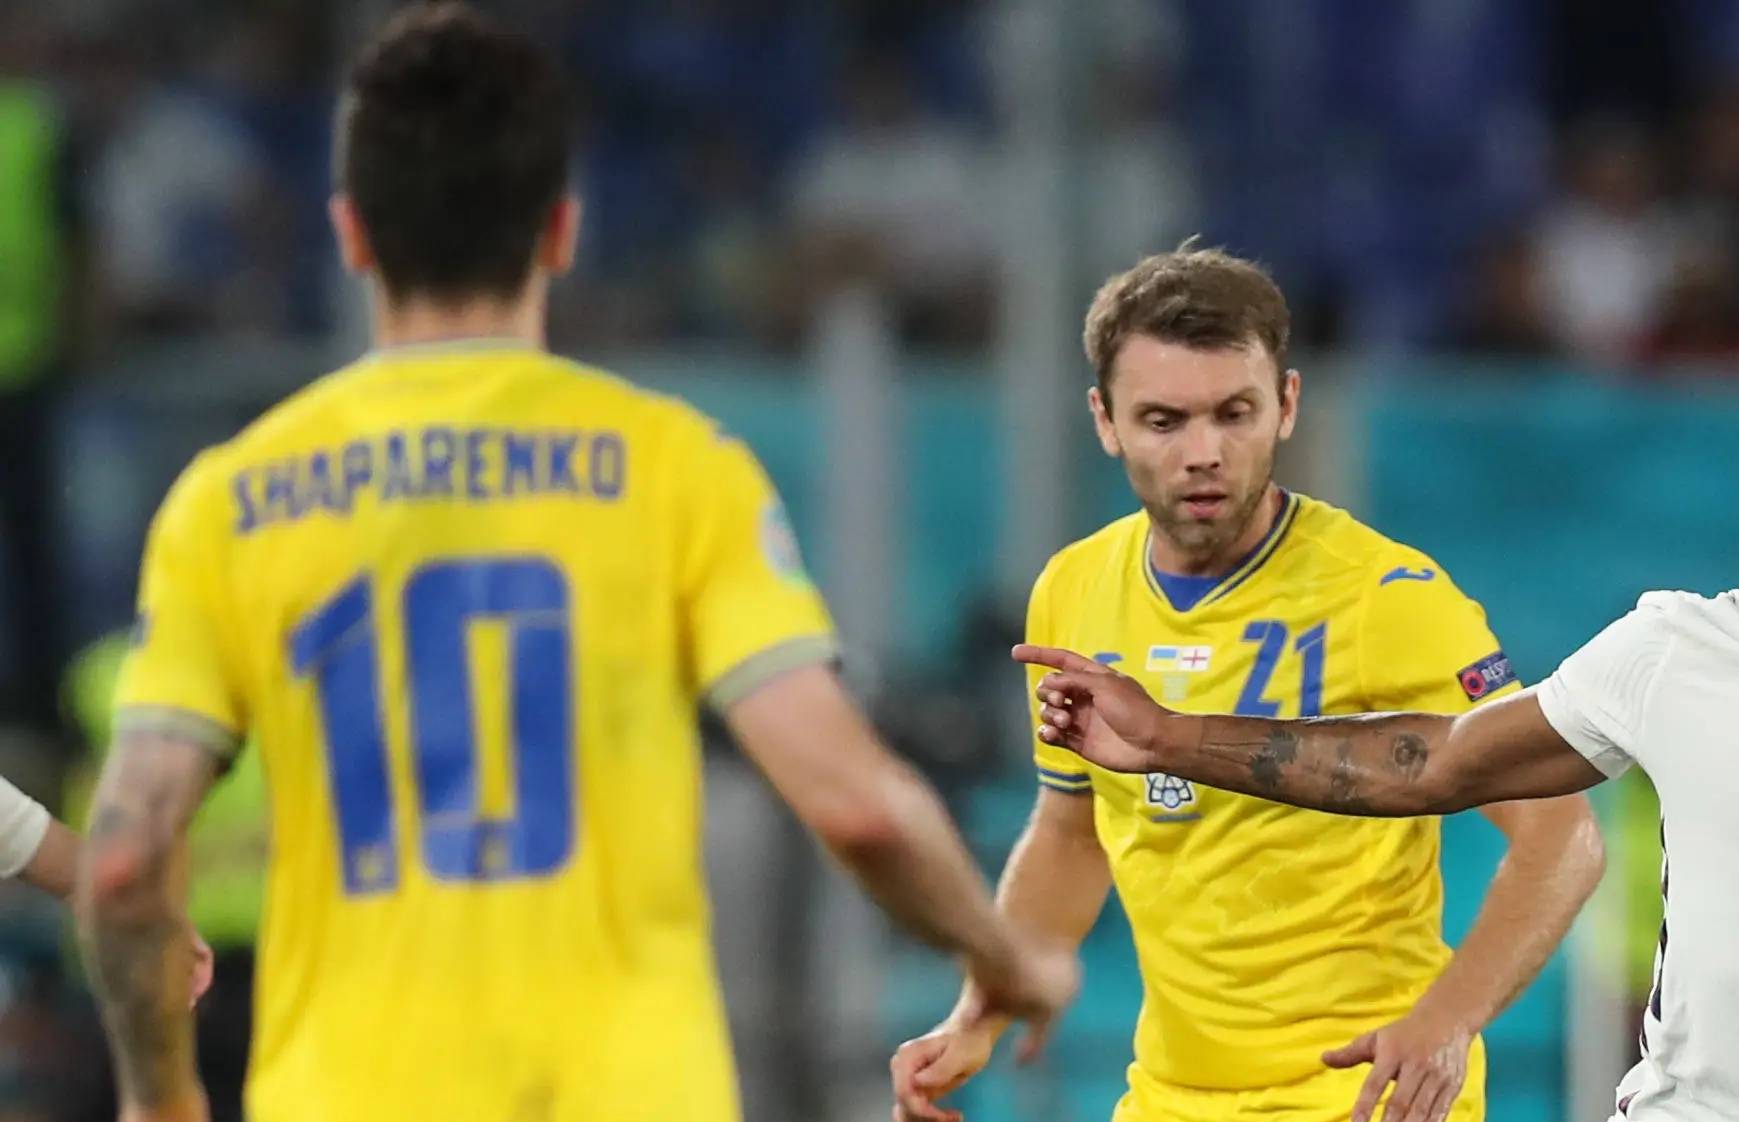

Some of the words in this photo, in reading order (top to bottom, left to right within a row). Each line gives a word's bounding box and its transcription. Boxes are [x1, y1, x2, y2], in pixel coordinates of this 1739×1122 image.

[231, 427, 626, 537] SHAPARENKO
[1233, 619, 1327, 717] 21
[287, 554, 576, 898] 10
